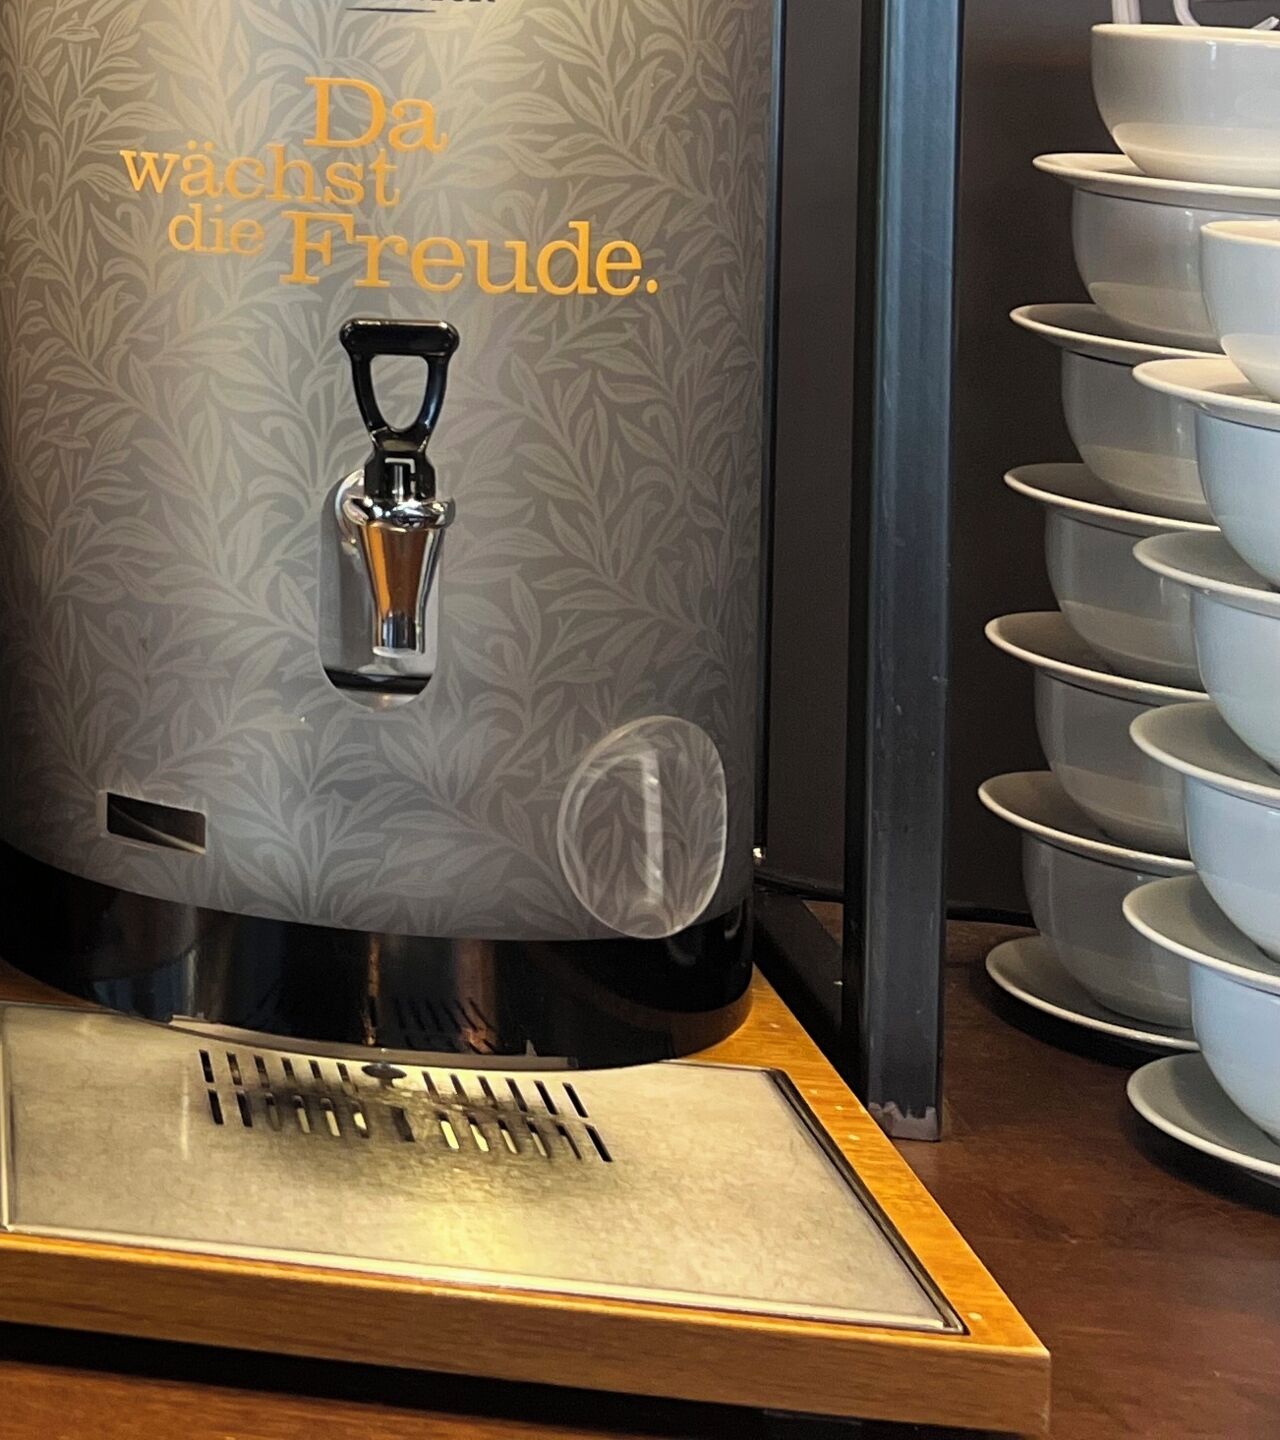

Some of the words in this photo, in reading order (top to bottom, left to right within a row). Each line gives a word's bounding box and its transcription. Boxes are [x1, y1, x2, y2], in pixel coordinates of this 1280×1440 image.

[303, 76, 449, 153] Da
[120, 140, 401, 208] wächst
[167, 203, 266, 256] die
[279, 210, 659, 296] Freude.
